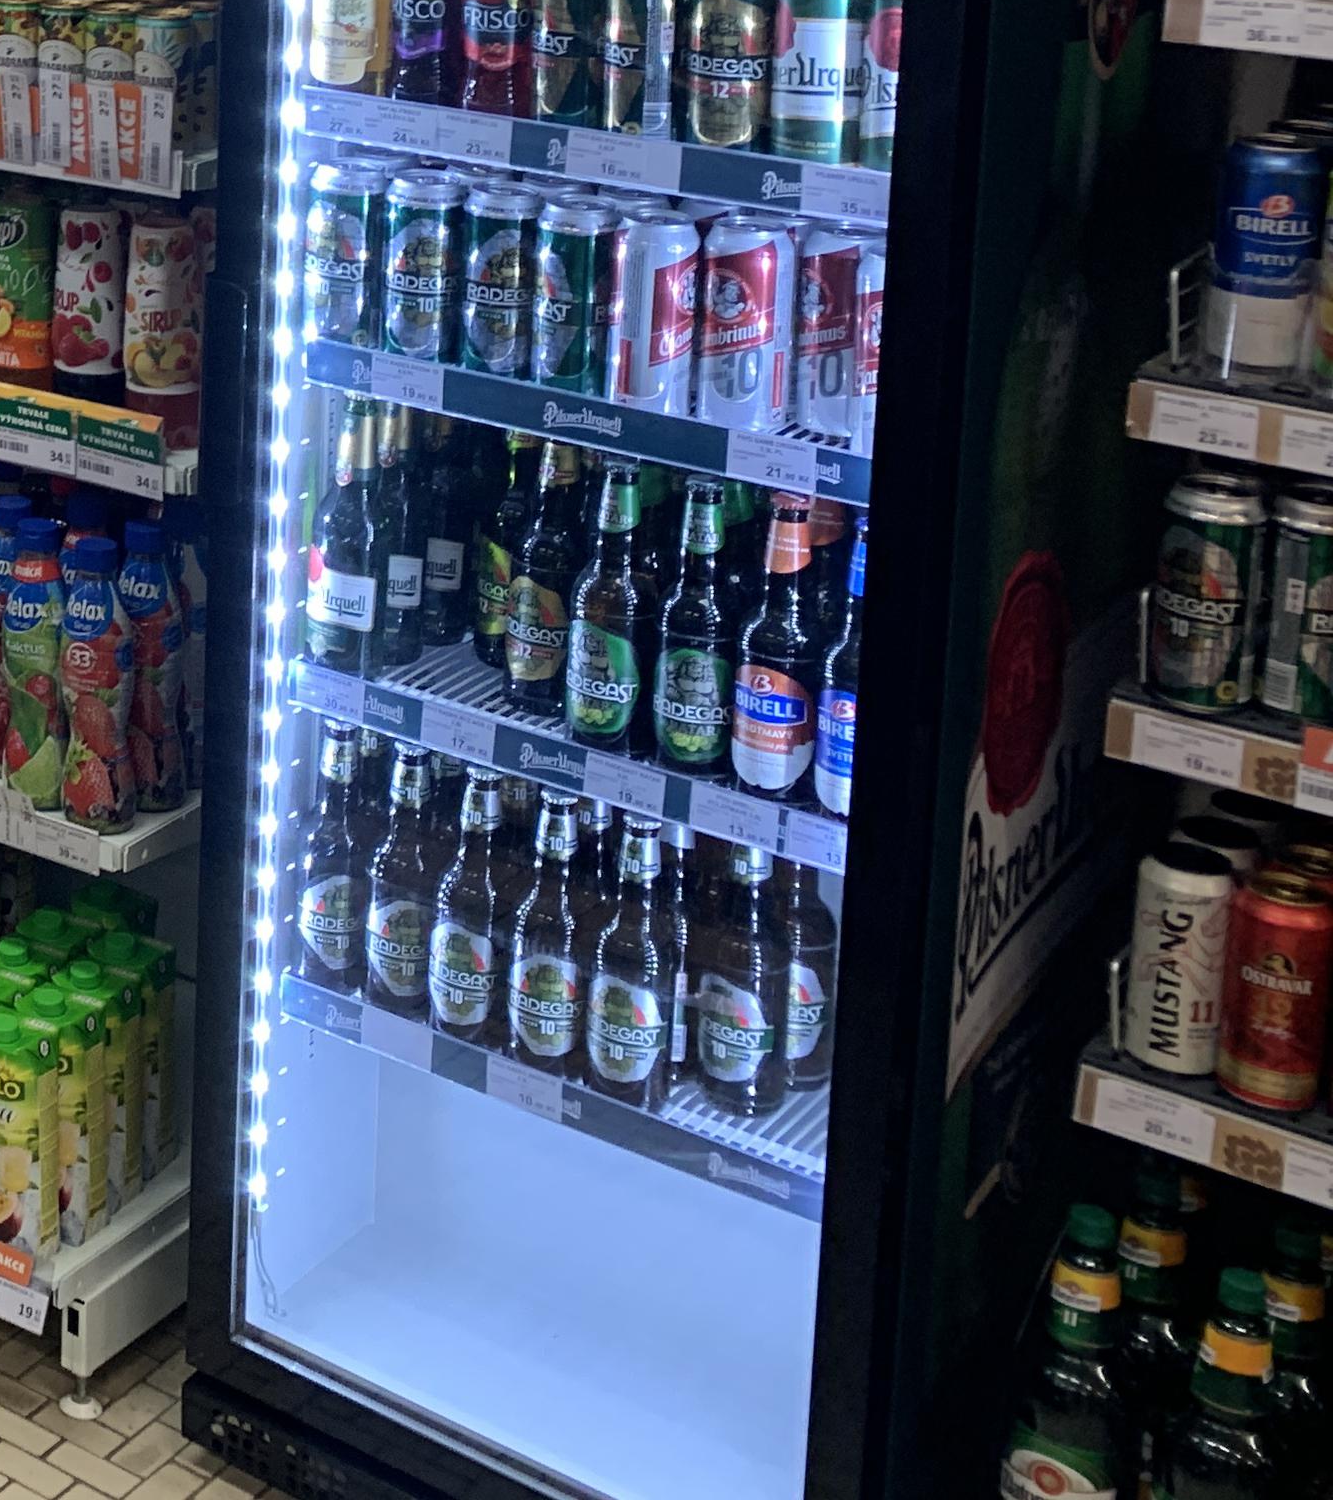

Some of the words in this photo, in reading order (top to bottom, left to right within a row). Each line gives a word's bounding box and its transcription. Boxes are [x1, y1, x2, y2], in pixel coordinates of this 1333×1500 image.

[463, 7, 530, 30] FRISCO
[710, 80, 730, 98] 12
[71, 96, 86, 164] AKCE
[119, 99, 137, 165] AKCE
[761, 170, 803, 200] Pilsne
[1235, 213, 1311, 237] BIRELL
[467, 282, 529, 301] RADEG
[721, 349, 763, 396] 10
[17, 405, 50, 421] TRVALE
[543, 400, 583, 428] Pilsner
[582, 407, 622, 437] Urquell
[0, 413, 44, 432] VÝHODNÁ
[45, 423, 69, 437] CENA
[100, 426, 136, 442] TRVALE
[129, 445, 155, 460] CENA
[736, 687, 797, 720] BIRELL
[519, 741, 560, 770] Pilsner
[307, 913, 355, 932] RADEG
[335, 934, 350, 950] 10
[370, 935, 422, 958] RADEG
[400, 961, 415, 977] 10
[1148, 909, 1194, 1059] MUSTANG
[448, 988, 464, 1005] 10
[510, 989, 583, 1019] RADEGAS
[1190, 1000, 1215, 1024] 11
[539, 1019, 556, 1036] 10
[608, 1043, 624, 1061] 10
